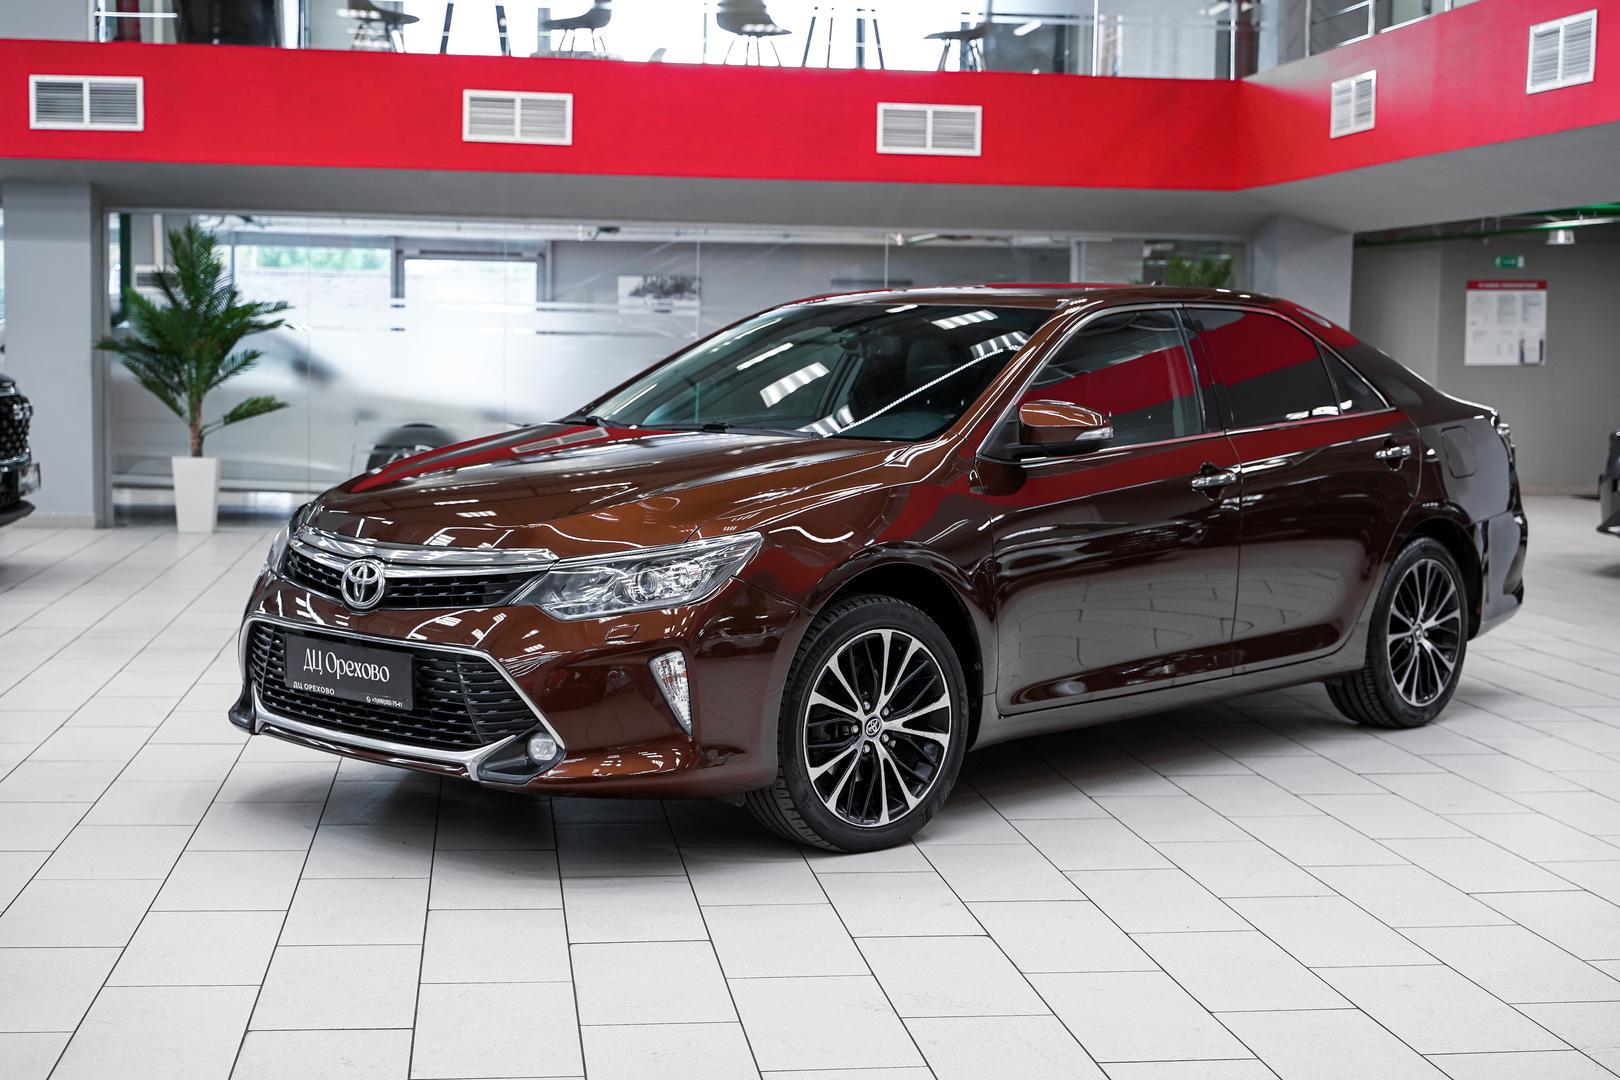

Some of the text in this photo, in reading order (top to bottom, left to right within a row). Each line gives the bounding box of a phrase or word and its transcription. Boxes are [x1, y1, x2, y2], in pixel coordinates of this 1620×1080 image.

[304, 648, 390, 683] ДЦ Орехово
[293, 681, 335, 695] ДЦ ОРЕХОВО
